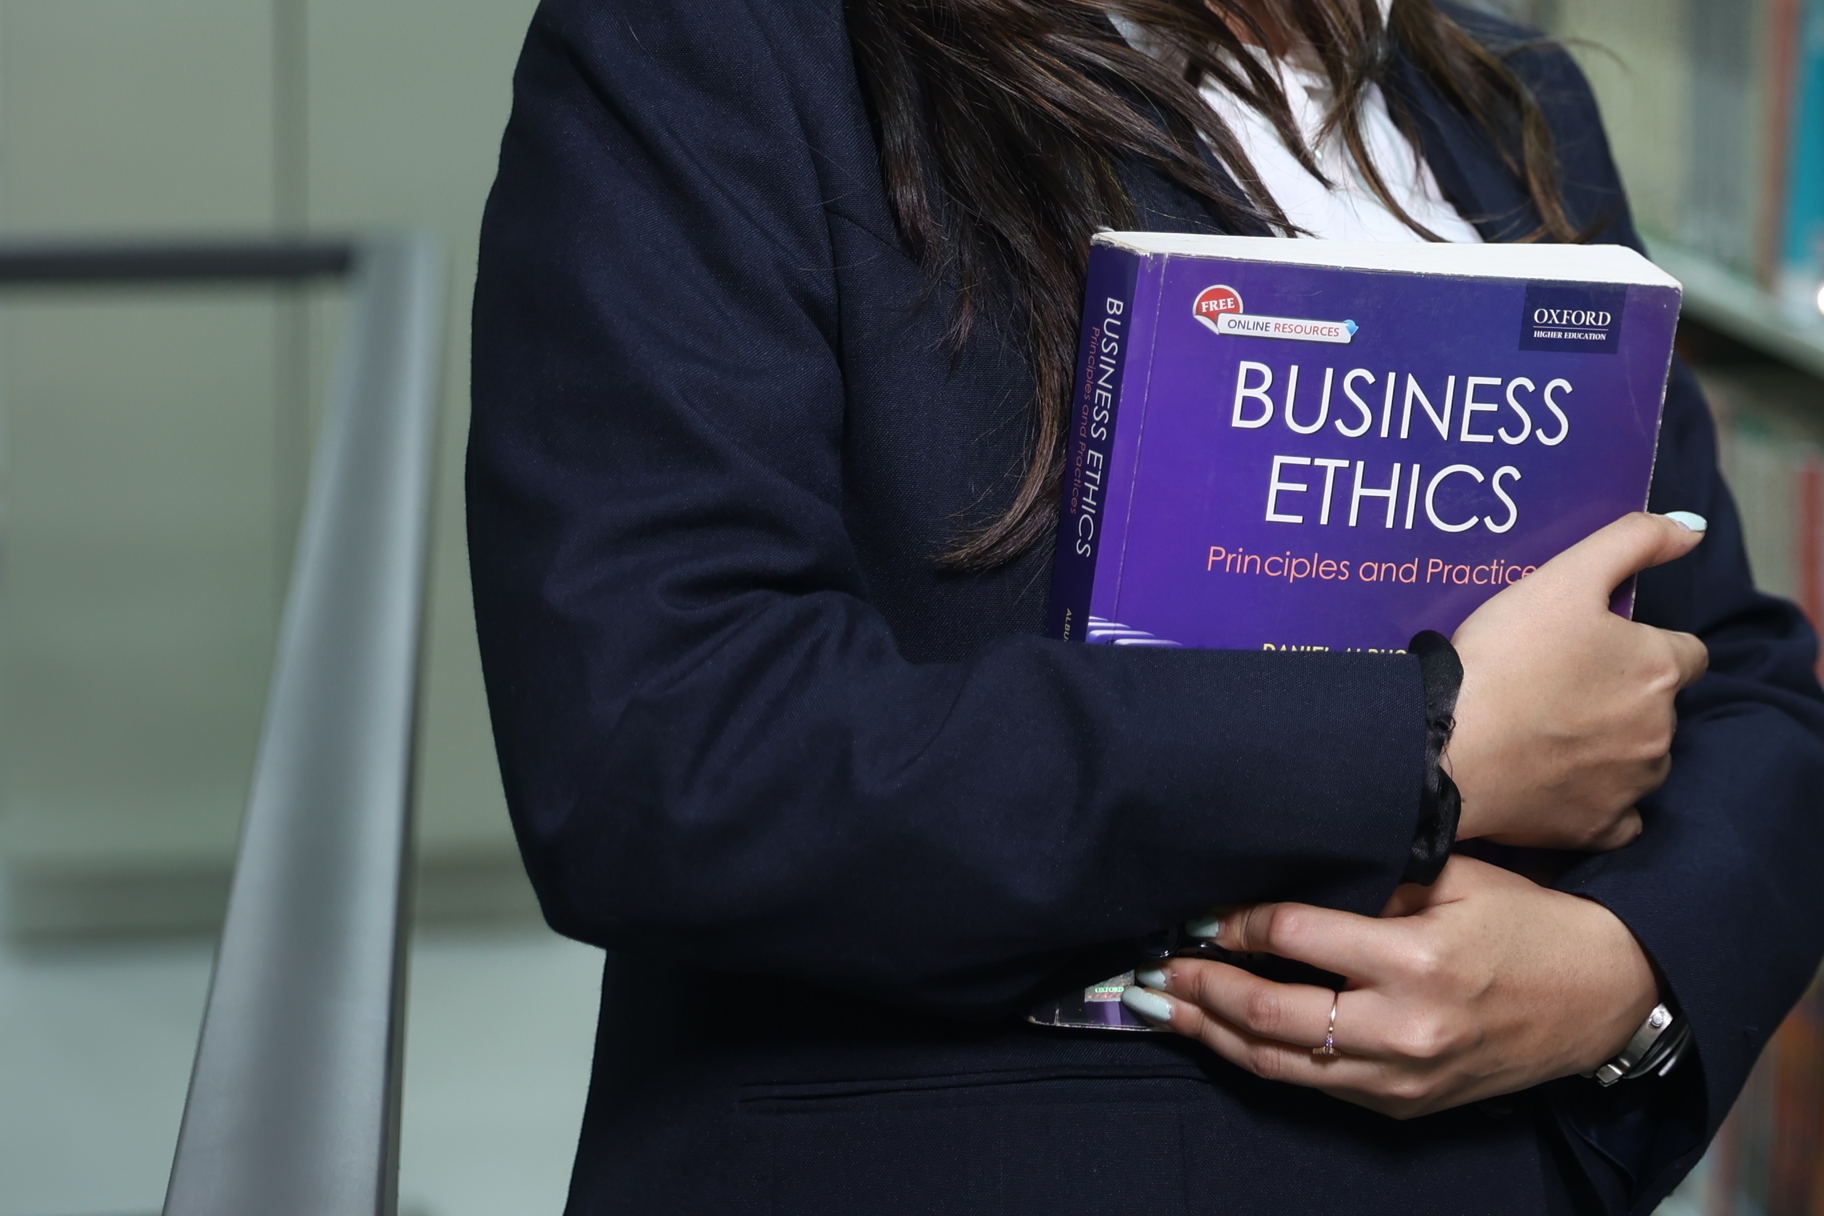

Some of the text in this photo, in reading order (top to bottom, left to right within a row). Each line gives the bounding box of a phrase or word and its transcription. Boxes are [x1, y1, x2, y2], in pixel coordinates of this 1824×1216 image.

[1200, 296, 1236, 315] FREE
[1532, 307, 1611, 327] OXFORD
[1226, 317, 1341, 339] ONLINE RESOURCES
[1532, 330, 1607, 342] HIGHER EDUCATION
[1069, 326, 1102, 516] Principles and Practices
[1230, 359, 1574, 447] BUSINESS
[1075, 296, 1125, 559] BUSINESS ETHICS
[1264, 454, 1523, 535] ETHICS
[1206, 545, 1350, 584] Principles
[1358, 557, 1419, 584] and
